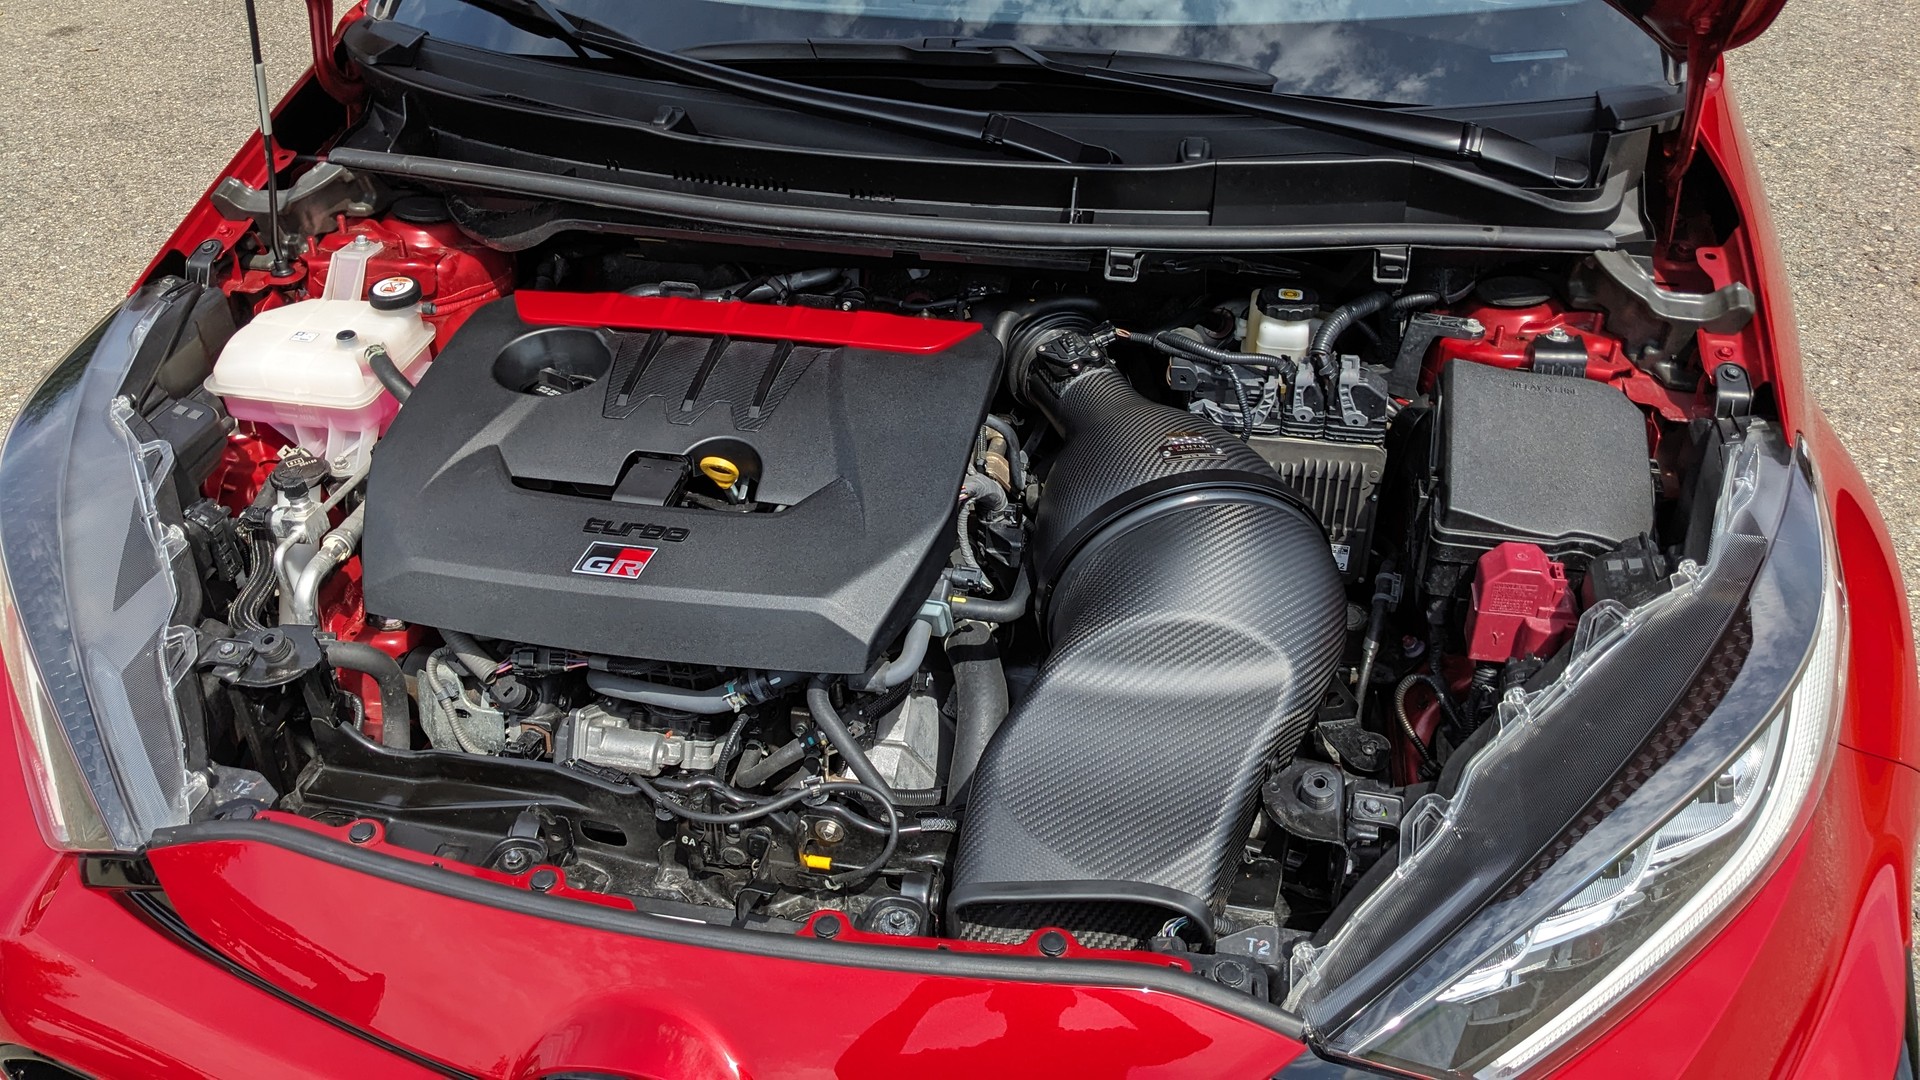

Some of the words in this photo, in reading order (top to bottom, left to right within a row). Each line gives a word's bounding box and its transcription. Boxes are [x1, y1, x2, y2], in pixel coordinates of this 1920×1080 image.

[582, 517, 691, 542] turbo
[581, 556, 644, 577] GR
[681, 835, 696, 847] 6A
[1245, 937, 1270, 956] T2
